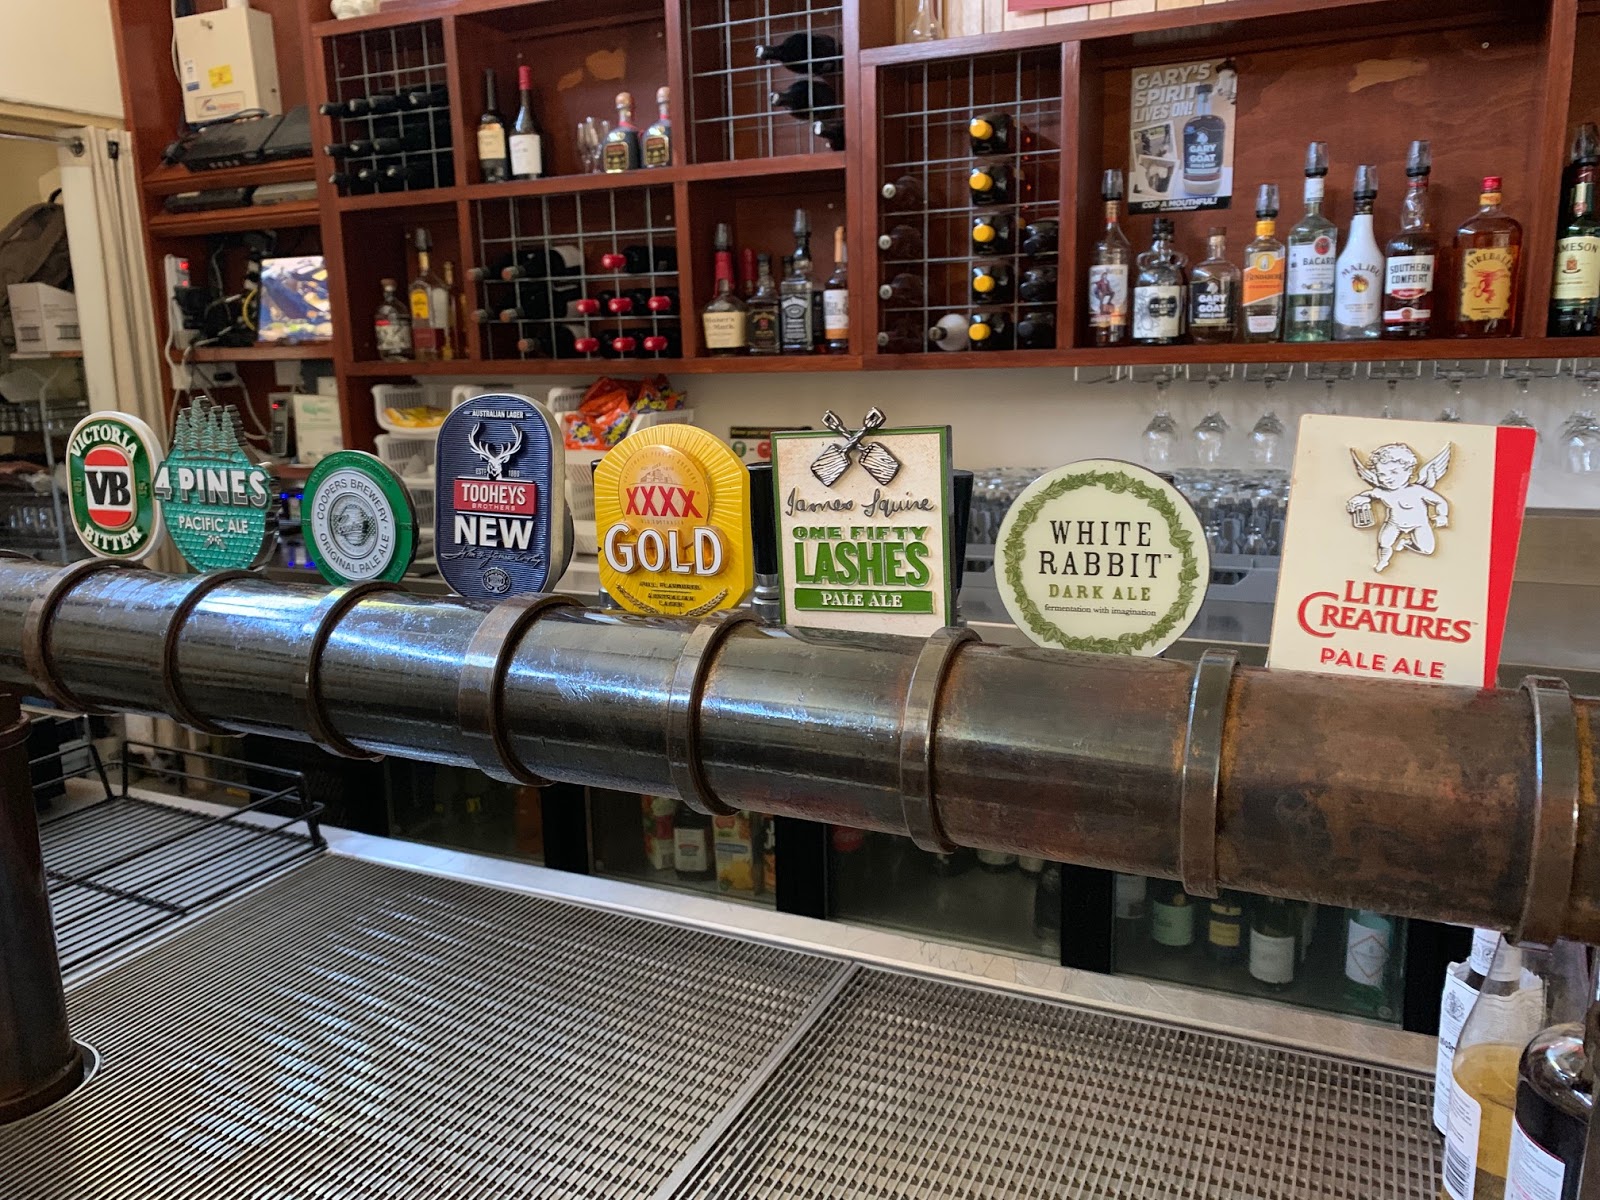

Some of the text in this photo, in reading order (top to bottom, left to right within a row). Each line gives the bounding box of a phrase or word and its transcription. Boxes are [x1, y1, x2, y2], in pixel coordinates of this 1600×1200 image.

[1133, 63, 1211, 90] GARY'S
[1133, 82, 1200, 107] SPIRIT
[1133, 101, 1194, 123] LIVES ON!
[1341, 262, 1380, 277] MALIBU
[1389, 263, 1431, 275] SOUTHERN
[1391, 273, 1428, 284] COMFORT
[1198, 294, 1227, 303] GARY
[1198, 304, 1226, 313] GOAT
[472, 409, 524, 419] AUSTRALIAN LAGER
[70, 423, 139, 461] VICTORIA
[84, 471, 131, 505] VB
[155, 467, 173, 501] 4
[178, 467, 269, 507] PINES
[316, 478, 389, 523] COOPERS BREWERY
[461, 482, 526, 506] TOOHEYS
[471, 503, 516, 511] BROTHERS
[626, 486, 703, 518] XXXX
[785, 487, 934, 518] James Squire
[82, 523, 143, 551] BITTER
[178, 516, 249, 534] PACIFIC ALE
[454, 515, 534, 550] NEW
[793, 526, 929, 540] ONE FIFTY
[1049, 520, 1151, 547] WHITE
[320, 532, 390, 574] ORIGINAL PALE ALE
[604, 523, 723, 576] GOLD
[794, 541, 930, 587] LASHES
[821, 591, 903, 608] PALE ALE
[1048, 583, 1151, 601] DARK ALE
[1343, 580, 1439, 612] LITTLE
[1044, 604, 1157, 617] fermentation with imagination
[1297, 591, 1472, 644] CREATURES
[1320, 647, 1446, 679] PALE ALE
